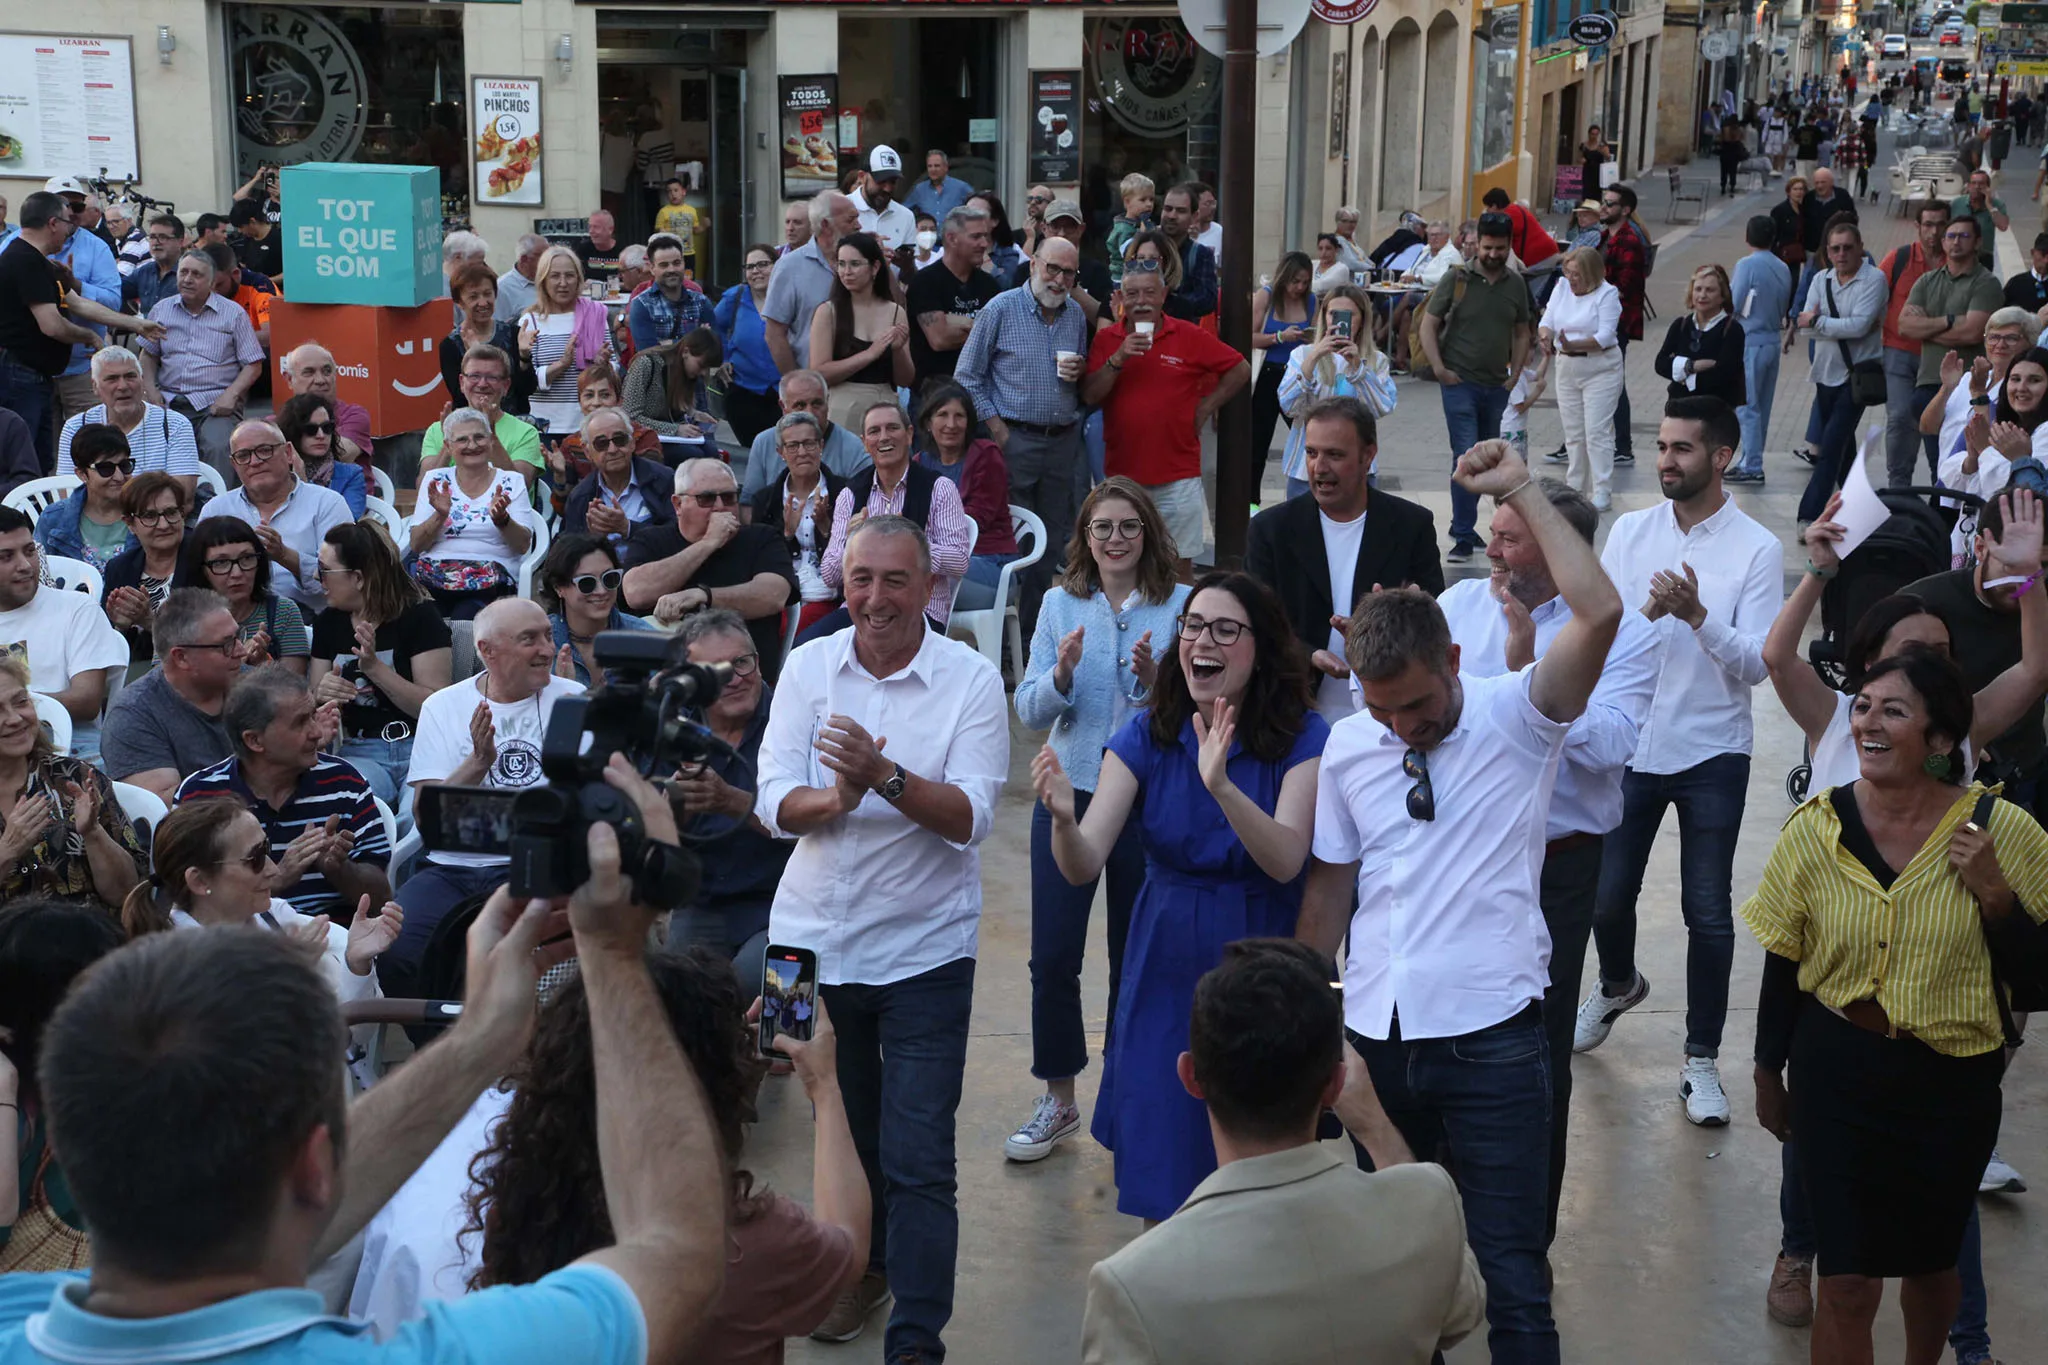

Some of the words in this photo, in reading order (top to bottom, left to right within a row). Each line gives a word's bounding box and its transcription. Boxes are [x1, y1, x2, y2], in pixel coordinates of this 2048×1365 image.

[1580, 26, 1602, 34] BAR
[59, 38, 102, 47] LIZARRAN
[483, 82, 531, 90] LIZARRAN
[791, 90, 826, 100] TODOS
[483, 98, 531, 113] PINCHOS
[801, 98, 832, 106] PINCHOS
[499, 121, 517, 133] 1,5€
[317, 198, 375, 222] TOT
[298, 226, 332, 249] EL
[338, 228, 397, 253] QUE
[316, 255, 380, 278] SOM
